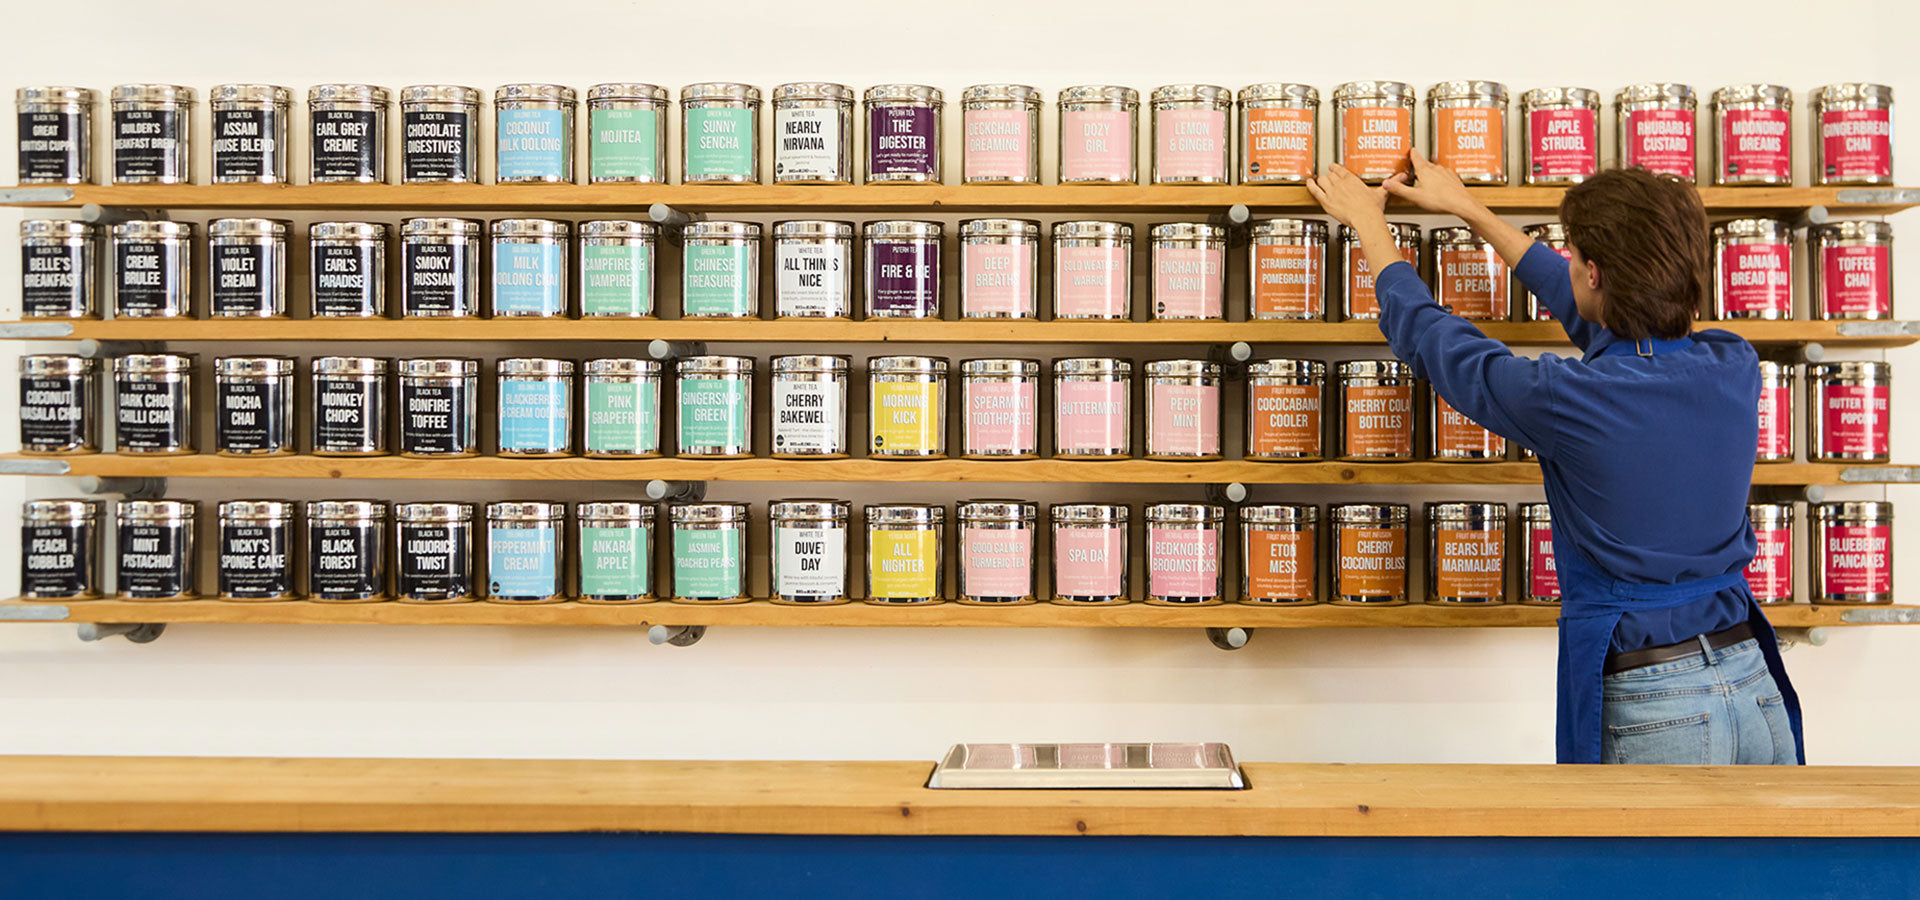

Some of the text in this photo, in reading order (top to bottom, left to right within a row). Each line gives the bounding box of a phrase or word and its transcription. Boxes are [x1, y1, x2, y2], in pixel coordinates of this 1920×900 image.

[33, 125, 58, 136] GREAT
[121, 123, 160, 133] BUILDER'S
[224, 123, 257, 135] ASSAM
[317, 123, 368, 135] EARL GREY
[408, 124, 461, 137] CHOCOLATE
[506, 122, 550, 134] COCONUT
[703, 121, 736, 133] SUNNY
[786, 121, 820, 134] NEARLY
[892, 120, 912, 133] THE
[969, 122, 1021, 136] DECKCHAIR
[1084, 124, 1110, 135] DOZY
[1175, 122, 1209, 134] LEMON
[1250, 122, 1312, 134] STRAWBERRY
[1363, 120, 1397, 133] LEMON
[1454, 120, 1487, 133] PEACH
[1548, 120, 1580, 134] APPLE
[1637, 121, 1681, 135] RHUBARB
[1732, 122, 1785, 135] MOONDROP
[1824, 122, 1889, 137] GINGERBREAD
[601, 130, 641, 143] MOJITEA
[701, 137, 739, 149] SENCHA
[880, 136, 925, 149] DIGESTER
[1458, 136, 1485, 149] SODA
[21, 141, 47, 151] BRITISH
[242, 140, 274, 151] BLEND
[324, 140, 357, 152] CREME
[408, 140, 461, 153] DIGESTIVES
[500, 138, 560, 151] MILK OOLONG
[784, 138, 824, 150] NIRVANA
[970, 139, 1018, 152] DREAMING
[1086, 140, 1108, 152] GIRL
[1170, 140, 1214, 151] & GINGER
[1256, 137, 1307, 150] LEMONADE
[1358, 137, 1402, 150] SHERBET
[1541, 137, 1586, 150] STRUDEL
[1643, 137, 1687, 151] CUSTARD
[1739, 137, 1781, 151] DREAMS
[1846, 137, 1871, 151] CHAI
[30, 258, 70, 270] BELLE'S
[126, 256, 158, 269] CREME
[221, 258, 254, 270] VIOLET
[325, 259, 356, 271] EARL'S
[416, 257, 450, 269] SMOKY
[514, 257, 538, 269] MILK
[694, 259, 734, 270] CHINESE
[784, 258, 800, 270] ALL
[985, 257, 1010, 269] DEEP
[1160, 262, 1216, 274] ENCHANTED
[1261, 259, 1311, 269] STRAWBERRY
[1740, 255, 1780, 268] BANANA
[1838, 258, 1875, 271] TOFFEE
[882, 265, 912, 278] FIRE &
[1447, 263, 1501, 276] BLUEBERRY
[125, 272, 160, 285] BRULEE
[221, 275, 256, 287] CREAM
[320, 275, 363, 288] PARADISE
[414, 273, 456, 285] RUSSIAN
[498, 273, 532, 285] OOLONG
[689, 276, 741, 288] TREASURES
[799, 275, 822, 286] NICE
[1262, 274, 1316, 285] POMEGRANATE
[1355, 276, 1373, 288] THE
[1731, 272, 1765, 286] BREAD
[1845, 274, 1869, 287] CHAI
[1455, 280, 1496, 292] & PEACH
[120, 394, 142, 407] DARK
[226, 396, 261, 409] MOCHA
[322, 394, 364, 406] MONKEY
[410, 399, 450, 412] BONFIRE
[608, 395, 632, 408] PINK
[786, 395, 823, 407] CHERRY
[974, 397, 1028, 409] SPEARMINT
[1170, 398, 1202, 411] PEPPY
[1257, 398, 1318, 411] COCOCABANA
[1349, 400, 1409, 412] CHERRY COLA
[1829, 398, 1860, 409] BUTTER
[694, 409, 726, 421] GREEN
[1062, 402, 1121, 415] BUTTERMINT
[120, 410, 146, 423] CHILLI
[232, 412, 255, 425] CHAI
[326, 410, 358, 422] CHOPS
[412, 415, 447, 428] TOFFEE
[893, 412, 916, 424] KICK
[973, 412, 1031, 425] TOOTHPASTE
[1173, 414, 1199, 427] MINT
[1270, 414, 1308, 427] COOLER
[1359, 416, 1401, 429] BOTTLES
[1443, 412, 1460, 424] THE
[33, 539, 66, 552] PEACH
[133, 539, 159, 551] MINT
[231, 540, 269, 552] VICKY'S
[322, 540, 354, 552] BLACK
[408, 541, 456, 554] LIQUORICE
[493, 541, 552, 554] PEPPERMINT
[593, 541, 632, 552] ANKARA
[688, 543, 720, 553] JASMINE
[893, 543, 912, 556] ALL
[1156, 542, 1214, 555] BEDKNOBS &
[1358, 541, 1393, 554] CHERRY
[1445, 543, 1499, 555] BEARS LIKE
[1830, 538, 1886, 551] BLUEBERRY
[124, 555, 172, 568] PISTACHIO
[1069, 549, 1109, 562] SPA DAY
[1833, 555, 1884, 568] PANCAKES
[28, 556, 74, 569] COBBLER
[222, 556, 284, 569] SPONGE CAKE
[320, 556, 357, 569] FOREST
[416, 557, 446, 570] TWIST
[504, 557, 538, 570] CREAM
[597, 557, 628, 569] APPLE
[802, 558, 820, 570] DAY
[882, 559, 924, 572] NIGHTER
[971, 558, 1024, 568] TURMERIC TEA
[1153, 559, 1216, 572] BROOMSTICKS
[1270, 561, 1297, 573] MESS
[1342, 557, 1405, 570] COCONUT BLISS
[1442, 559, 1500, 571] MARMALADE
